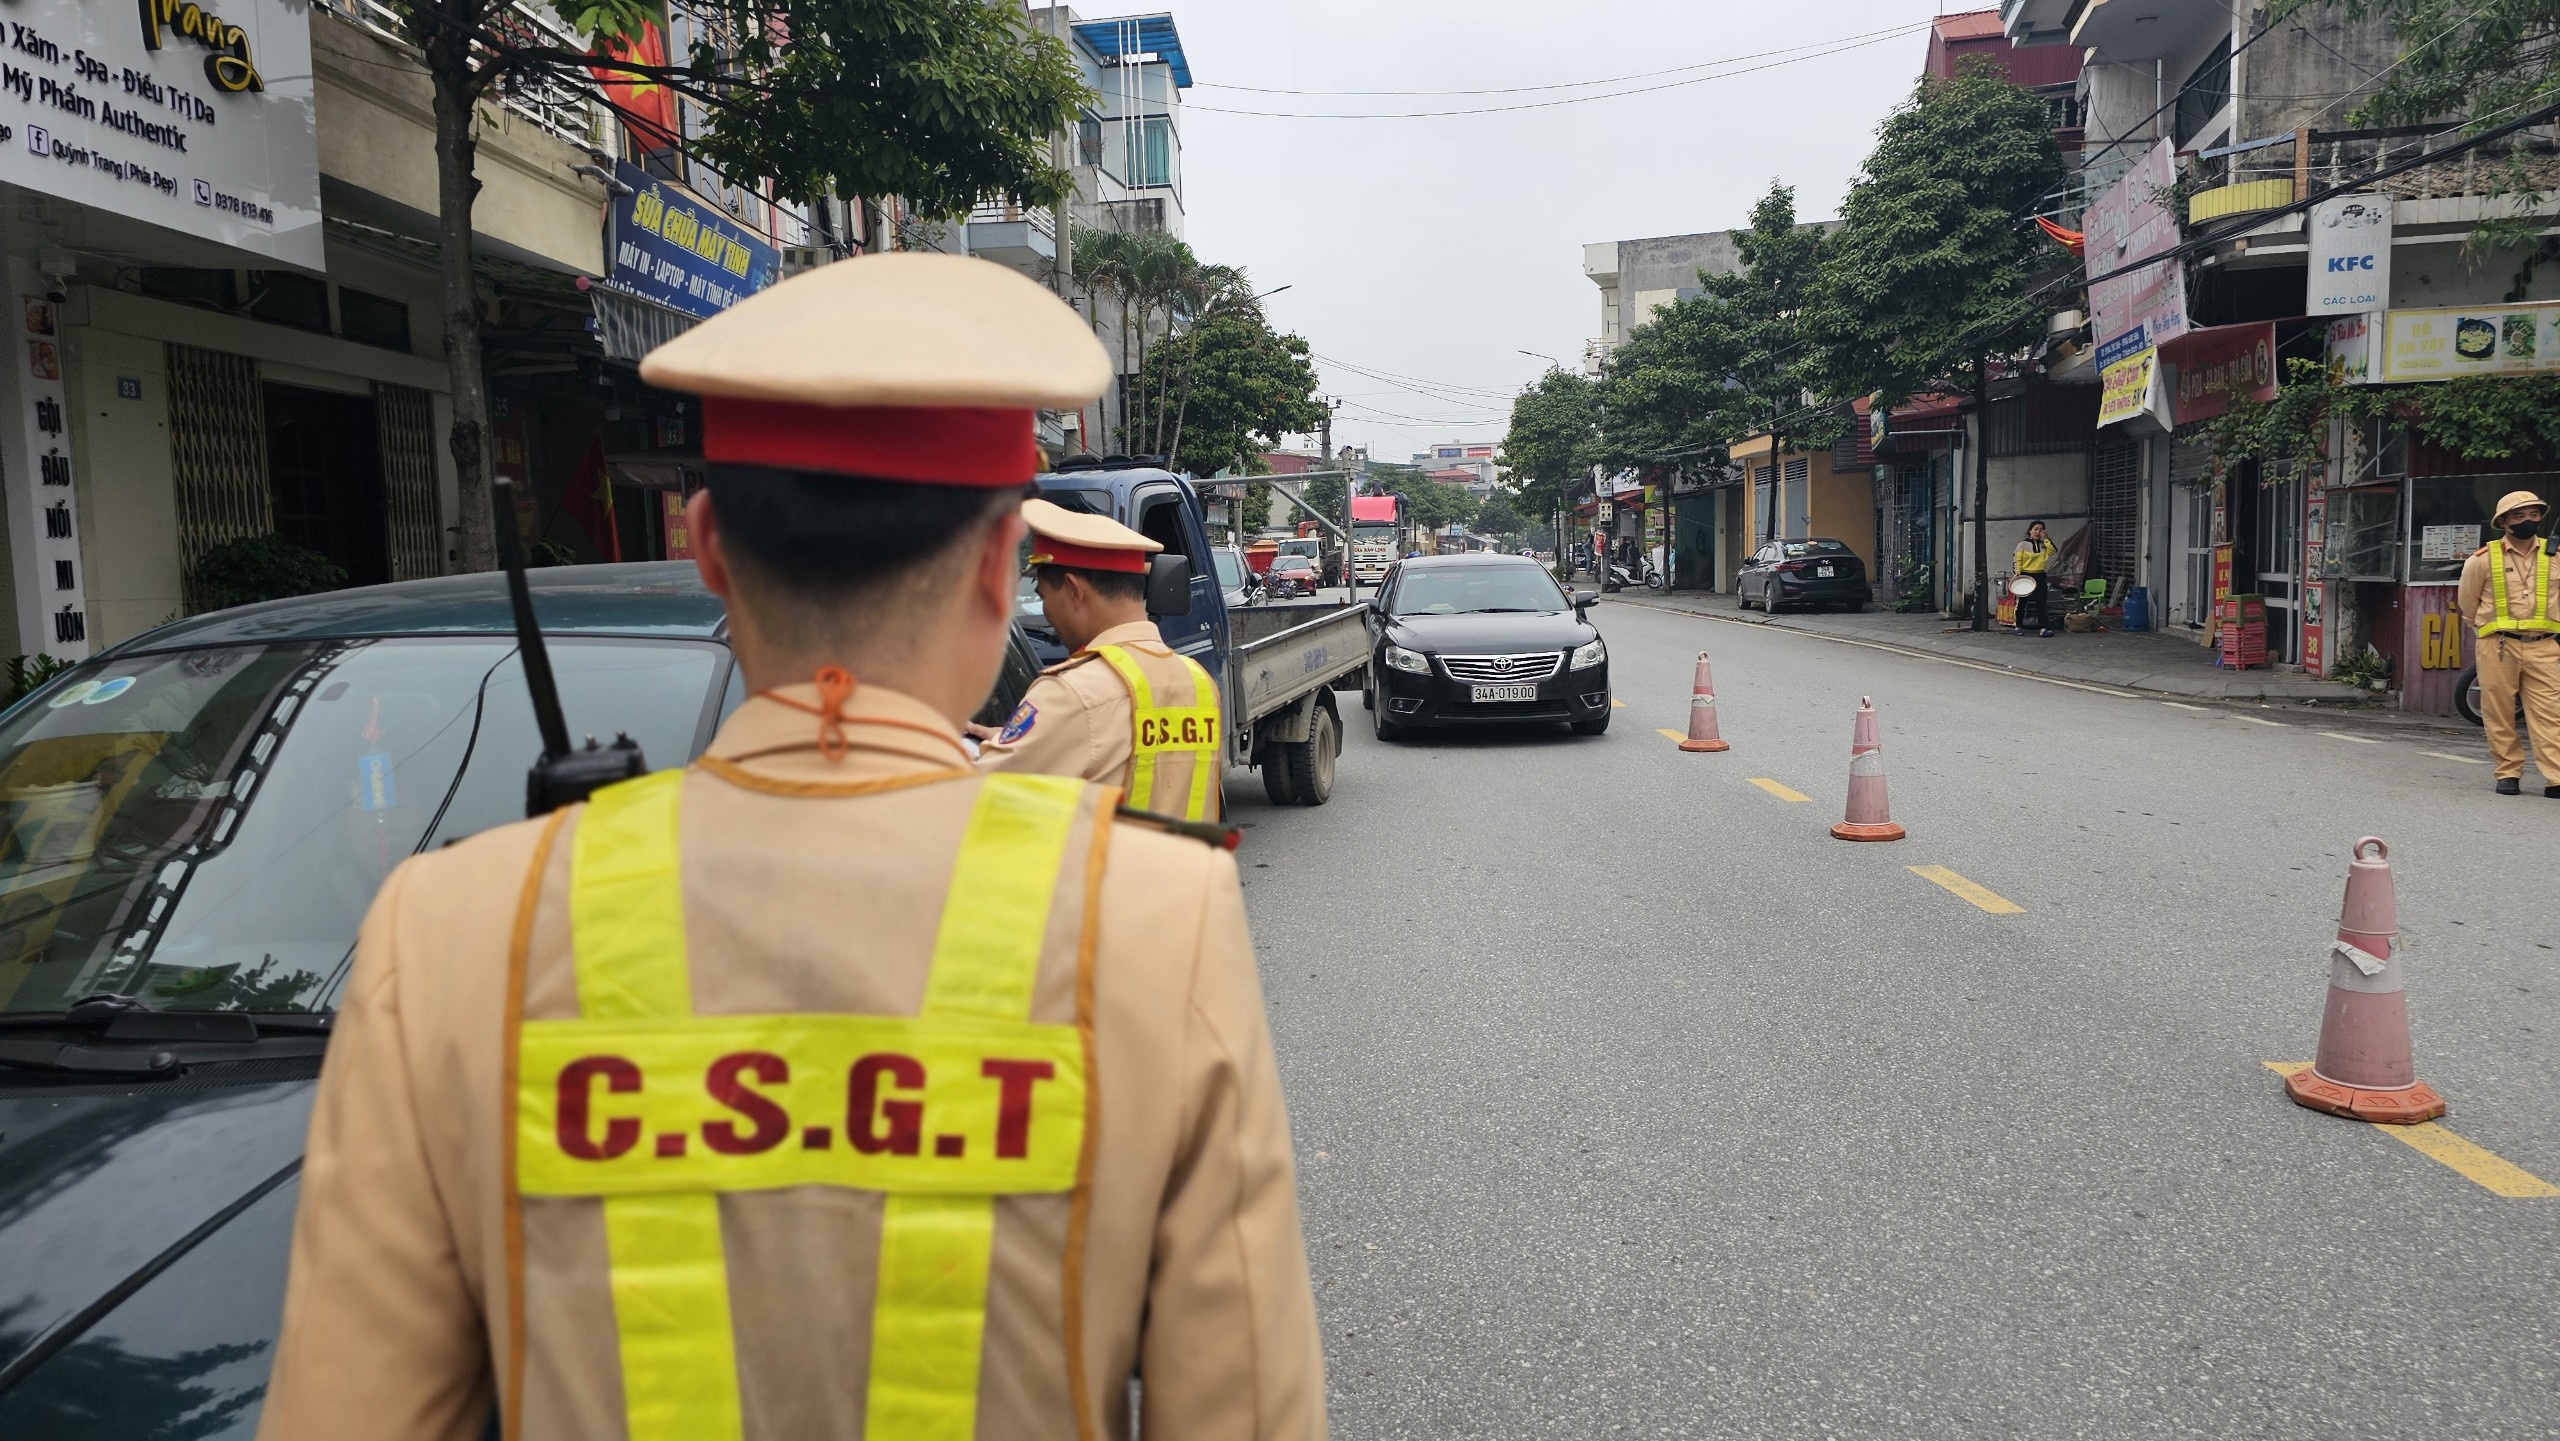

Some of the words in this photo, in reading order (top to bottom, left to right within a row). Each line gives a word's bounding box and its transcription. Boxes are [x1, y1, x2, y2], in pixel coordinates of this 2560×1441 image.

[11, 22, 59, 64] Xăm
[75, 50, 109, 83] Spa
[121, 67, 163, 105] Điều
[166, 85, 191, 120] Trị
[194, 96, 215, 125] Da
[3, 62, 33, 101] Mỹ
[39, 76, 95, 121] Phẩm
[101, 100, 188, 154] Authentic
[52, 139, 89, 166] Quỳnh
[90, 150, 123, 180] Trang
[215, 192, 240, 213] 0378
[632, 183, 664, 237] SỬA
[662, 205, 699, 250] CHỮA
[696, 220, 725, 267] MÁY
[722, 231, 752, 280] TÍNH
[618, 240, 641, 271] MÁY
[638, 251, 651, 275] IN
[654, 258, 685, 290] LAPTOP
[689, 273, 708, 301] MÁY
[706, 279, 724, 308] TÍNH
[2327, 255, 2374, 272] KFC
[2323, 296, 2347, 306] CÁC
[122, 382, 137, 396] 33
[46, 499, 72, 538] NỐI
[55, 560, 74, 590] MI
[54, 603, 85, 642] UỐN
[2420, 602, 2462, 669] GÀ
[2307, 636, 2318, 655] 38
[1474, 686, 1535, 700] 34A-019.00
[1141, 716, 1215, 747] C.S.G.T
[555, 1050, 1056, 1162] C.S.G.T
